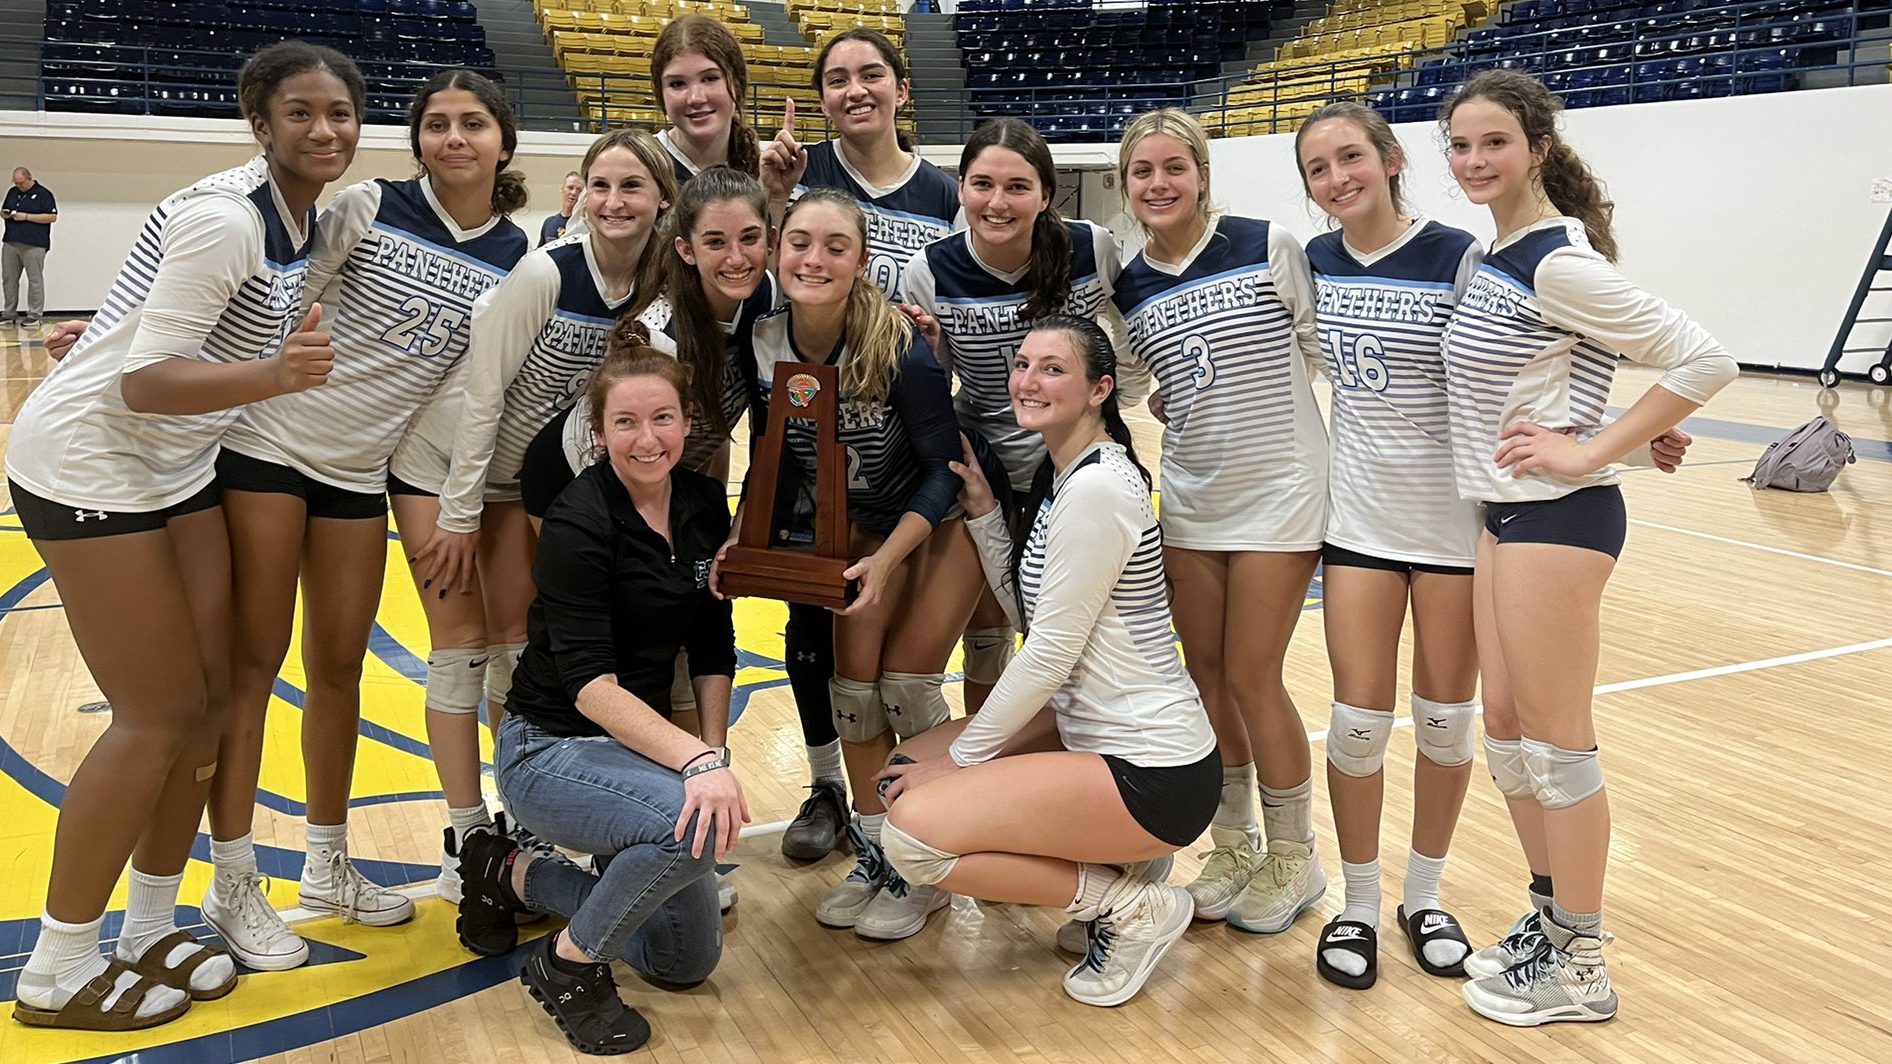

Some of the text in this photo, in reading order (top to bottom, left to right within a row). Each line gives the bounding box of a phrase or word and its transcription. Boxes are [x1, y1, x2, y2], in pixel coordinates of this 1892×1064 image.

[380, 295, 468, 358] 25
[1133, 276, 1258, 343] PANTHERS
[1181, 333, 1217, 390] 3
[1328, 328, 1389, 393] 16
[1333, 925, 1362, 937] NIKE
[1425, 914, 1449, 926] NIKE
